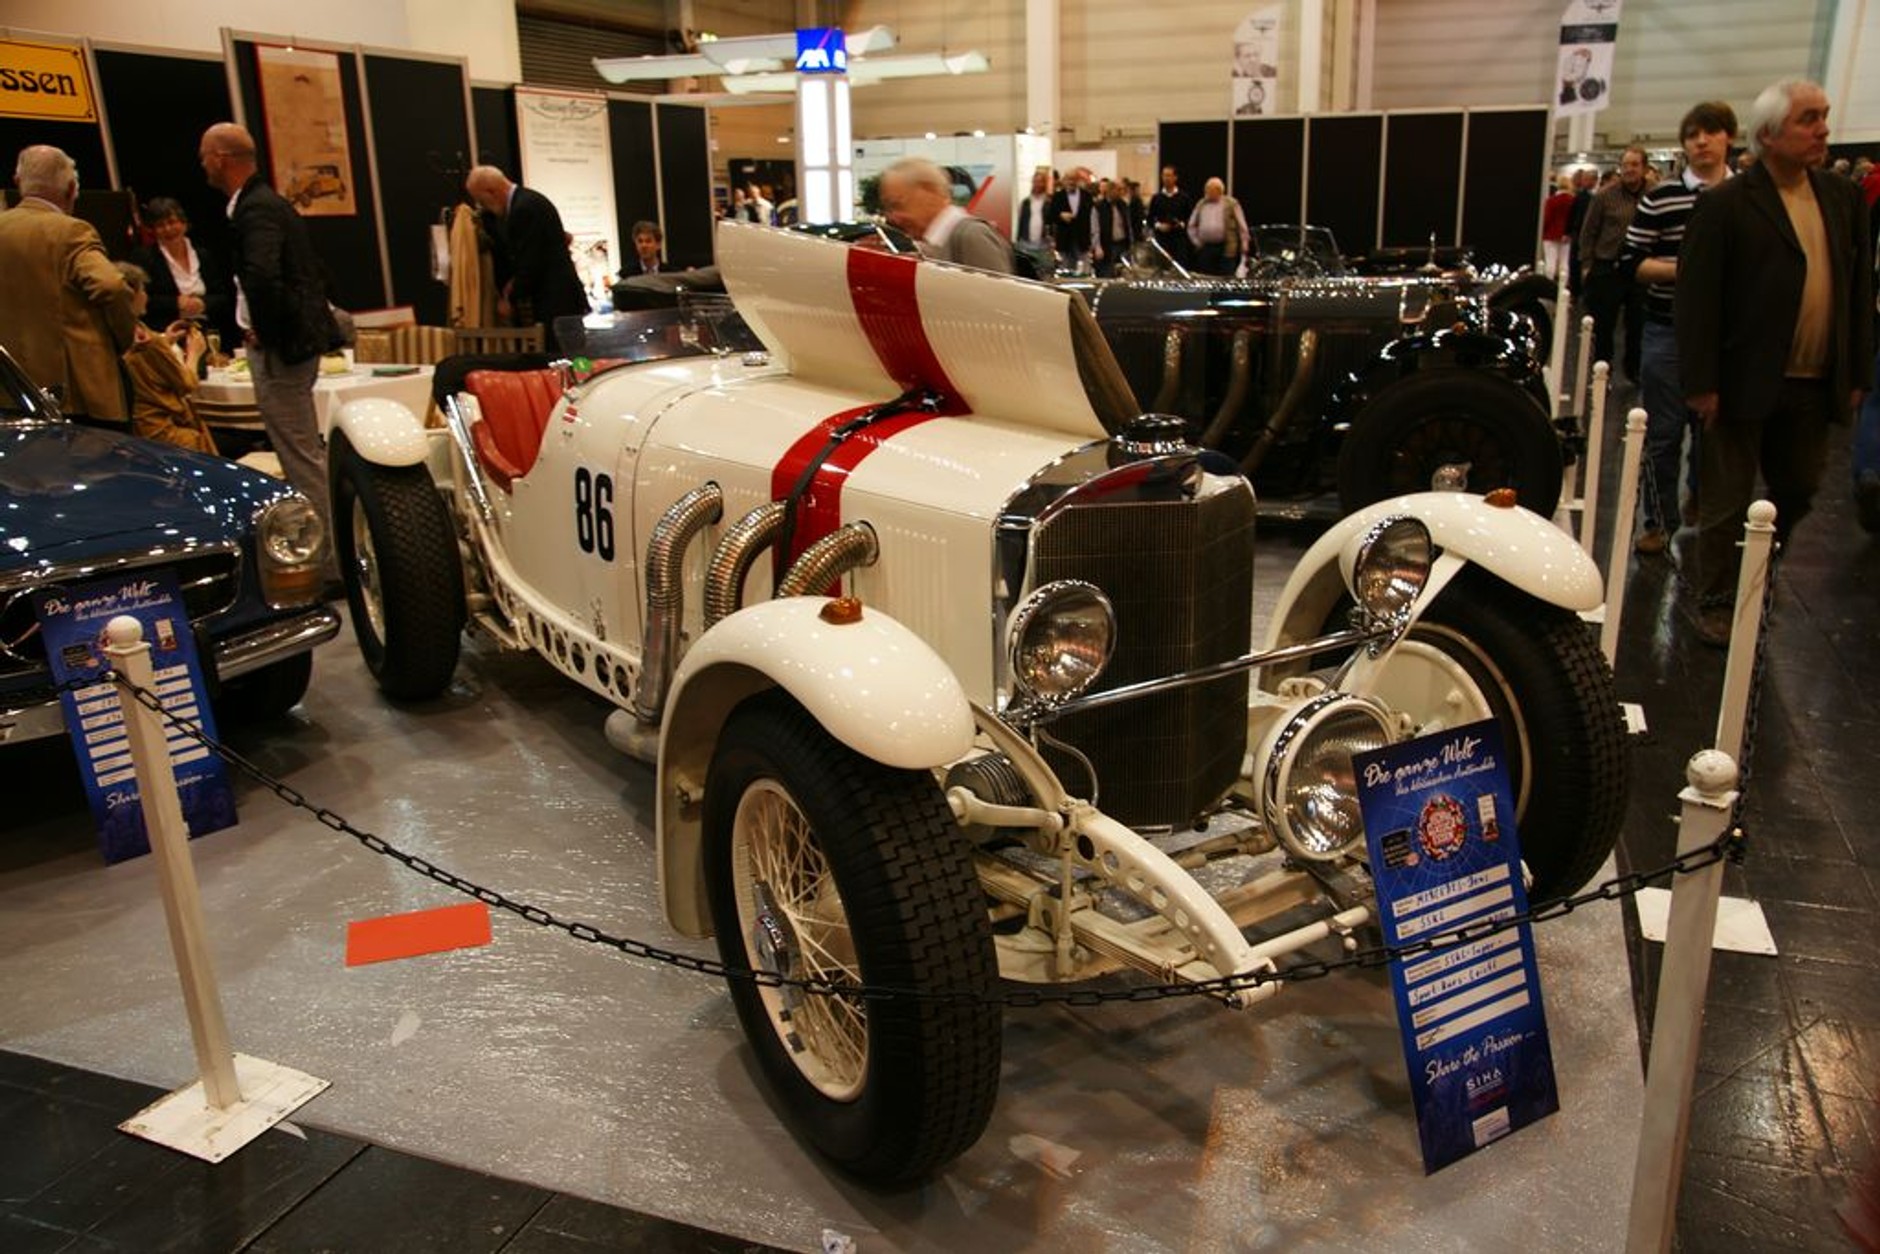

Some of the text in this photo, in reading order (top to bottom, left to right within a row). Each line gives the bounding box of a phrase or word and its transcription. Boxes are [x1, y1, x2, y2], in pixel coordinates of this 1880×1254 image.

[575, 466, 615, 562] 86
[1363, 760, 1393, 788] Die
[1440, 735, 1482, 765] Welt
[1425, 1058, 1460, 1086] Share
